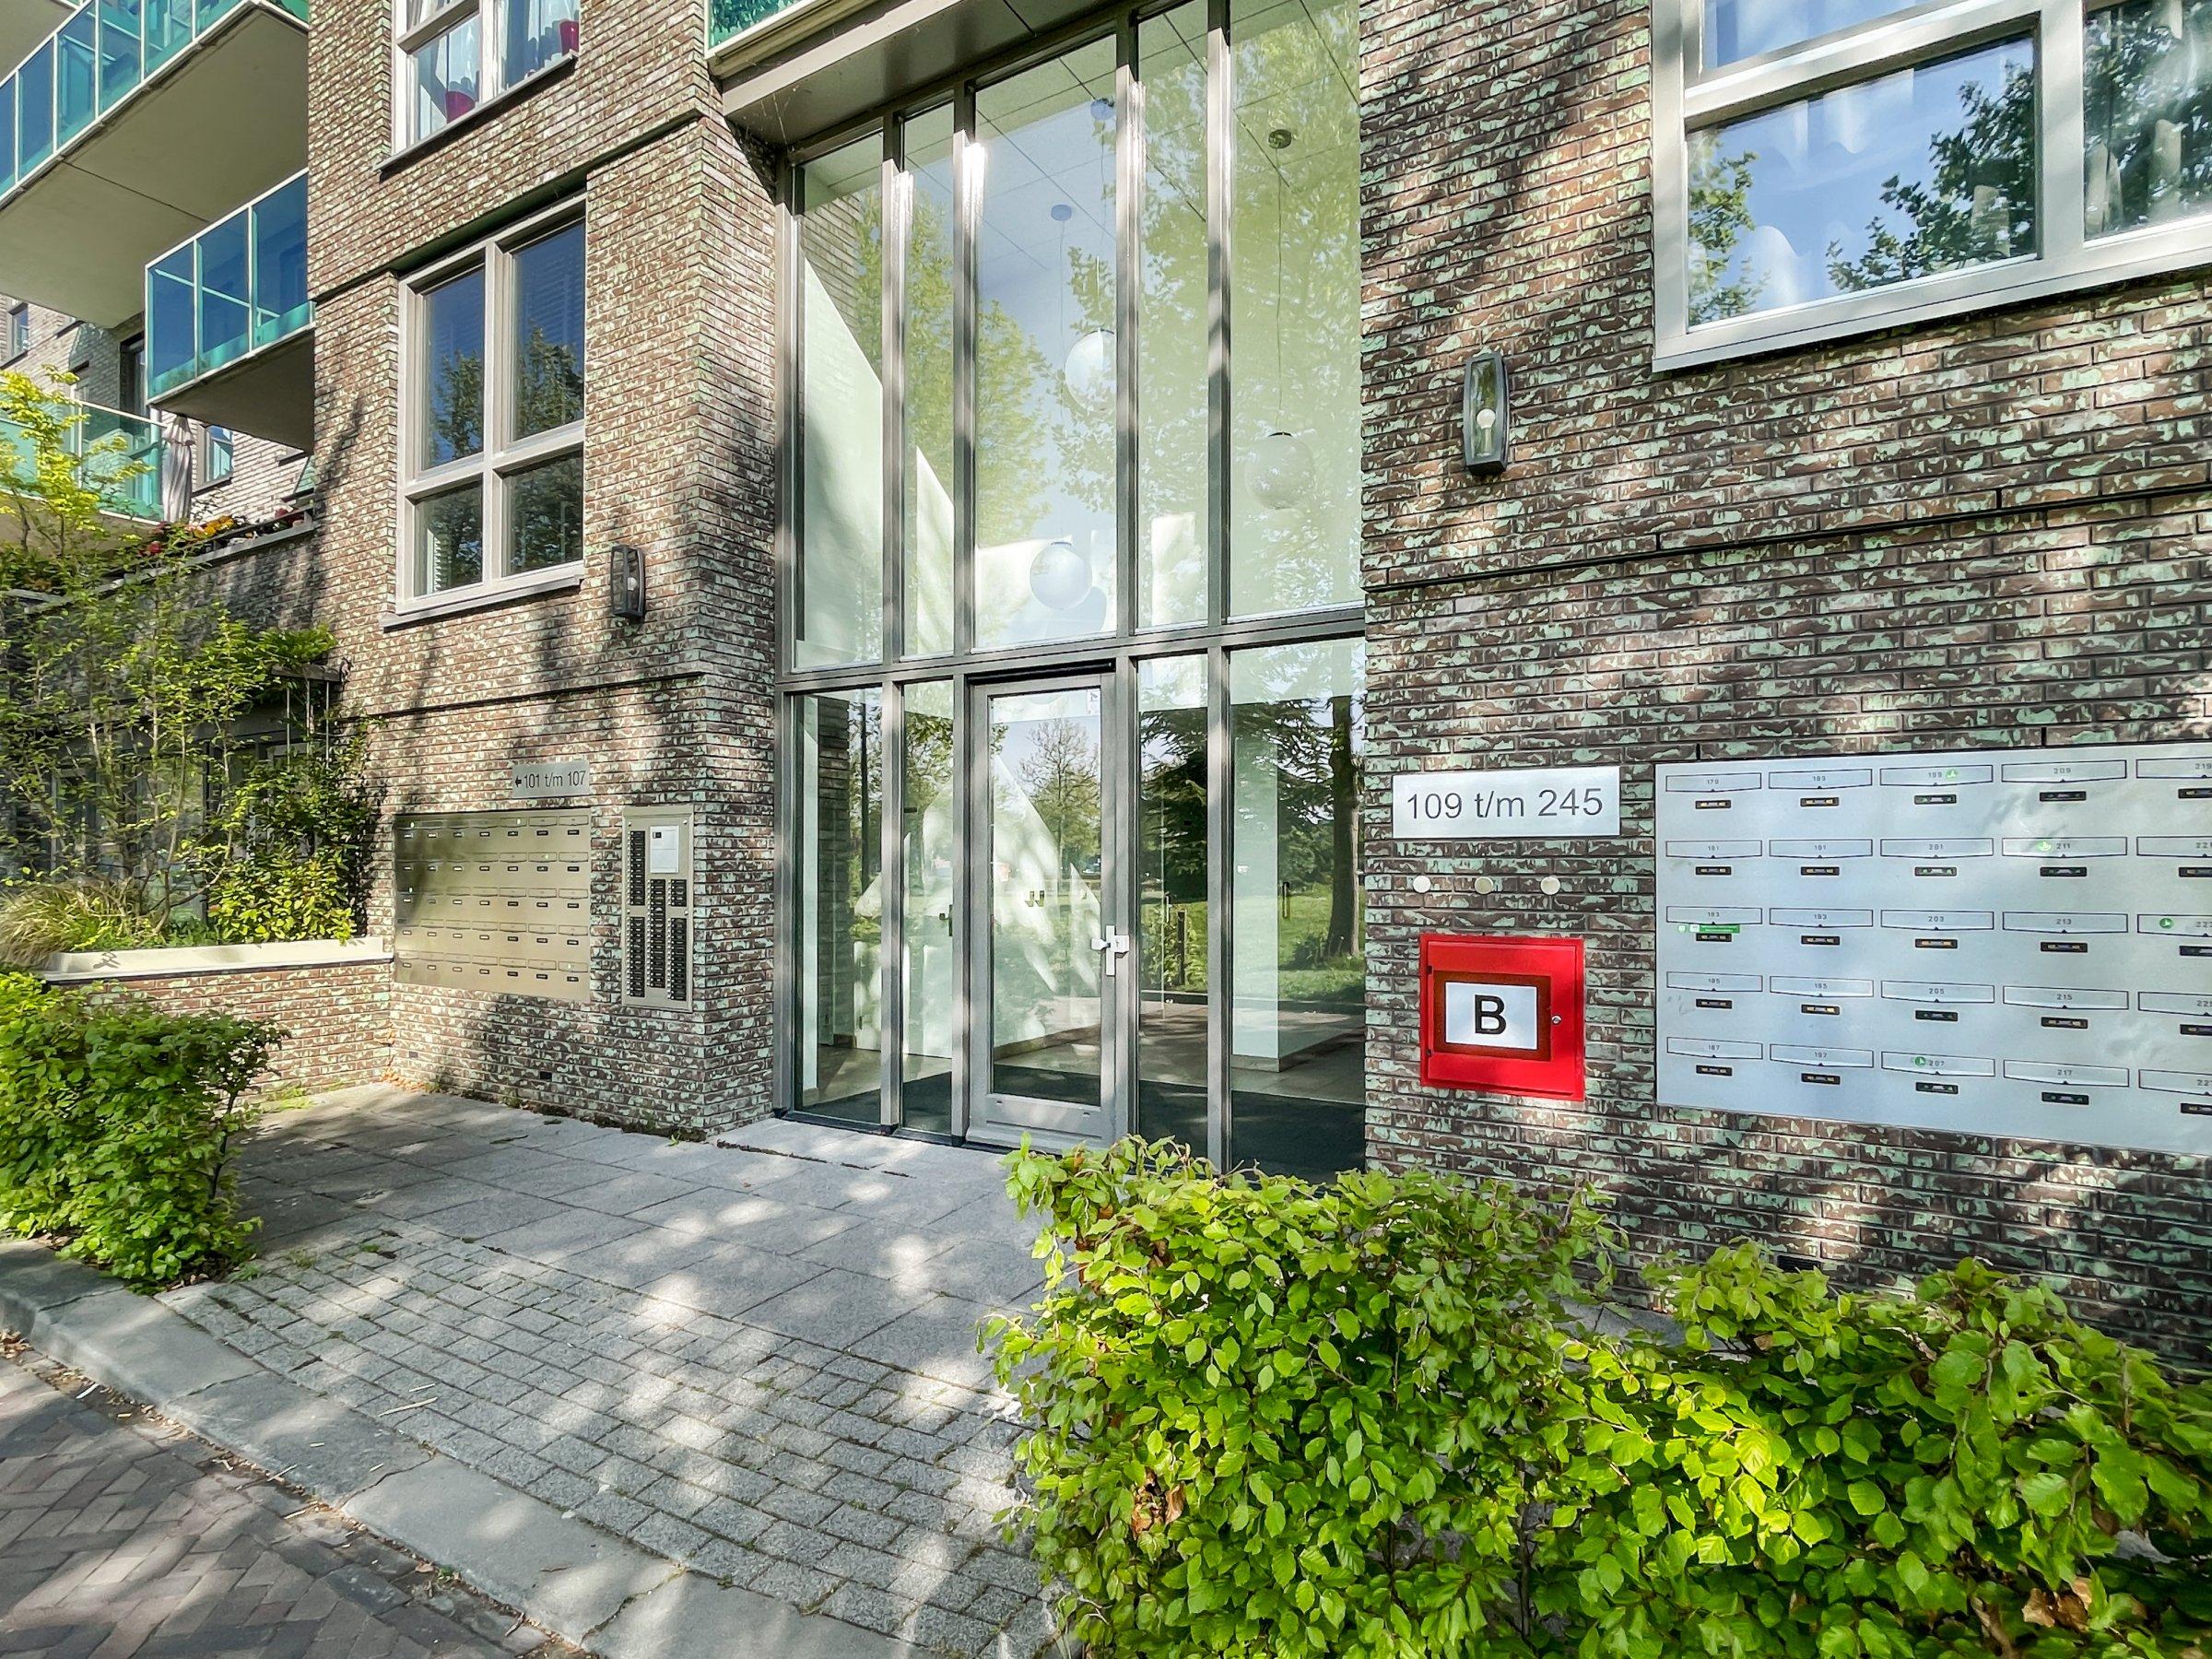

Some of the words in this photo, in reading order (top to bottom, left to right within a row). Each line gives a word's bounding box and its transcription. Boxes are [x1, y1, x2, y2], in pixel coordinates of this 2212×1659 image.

[524, 773, 540, 788] 101
[545, 772, 563, 787] t/m
[568, 771, 586, 786] 107
[1407, 793, 1463, 819] 109
[1475, 791, 1524, 818] t/m
[1537, 788, 1603, 817] 245
[1474, 994, 1507, 1035] B
